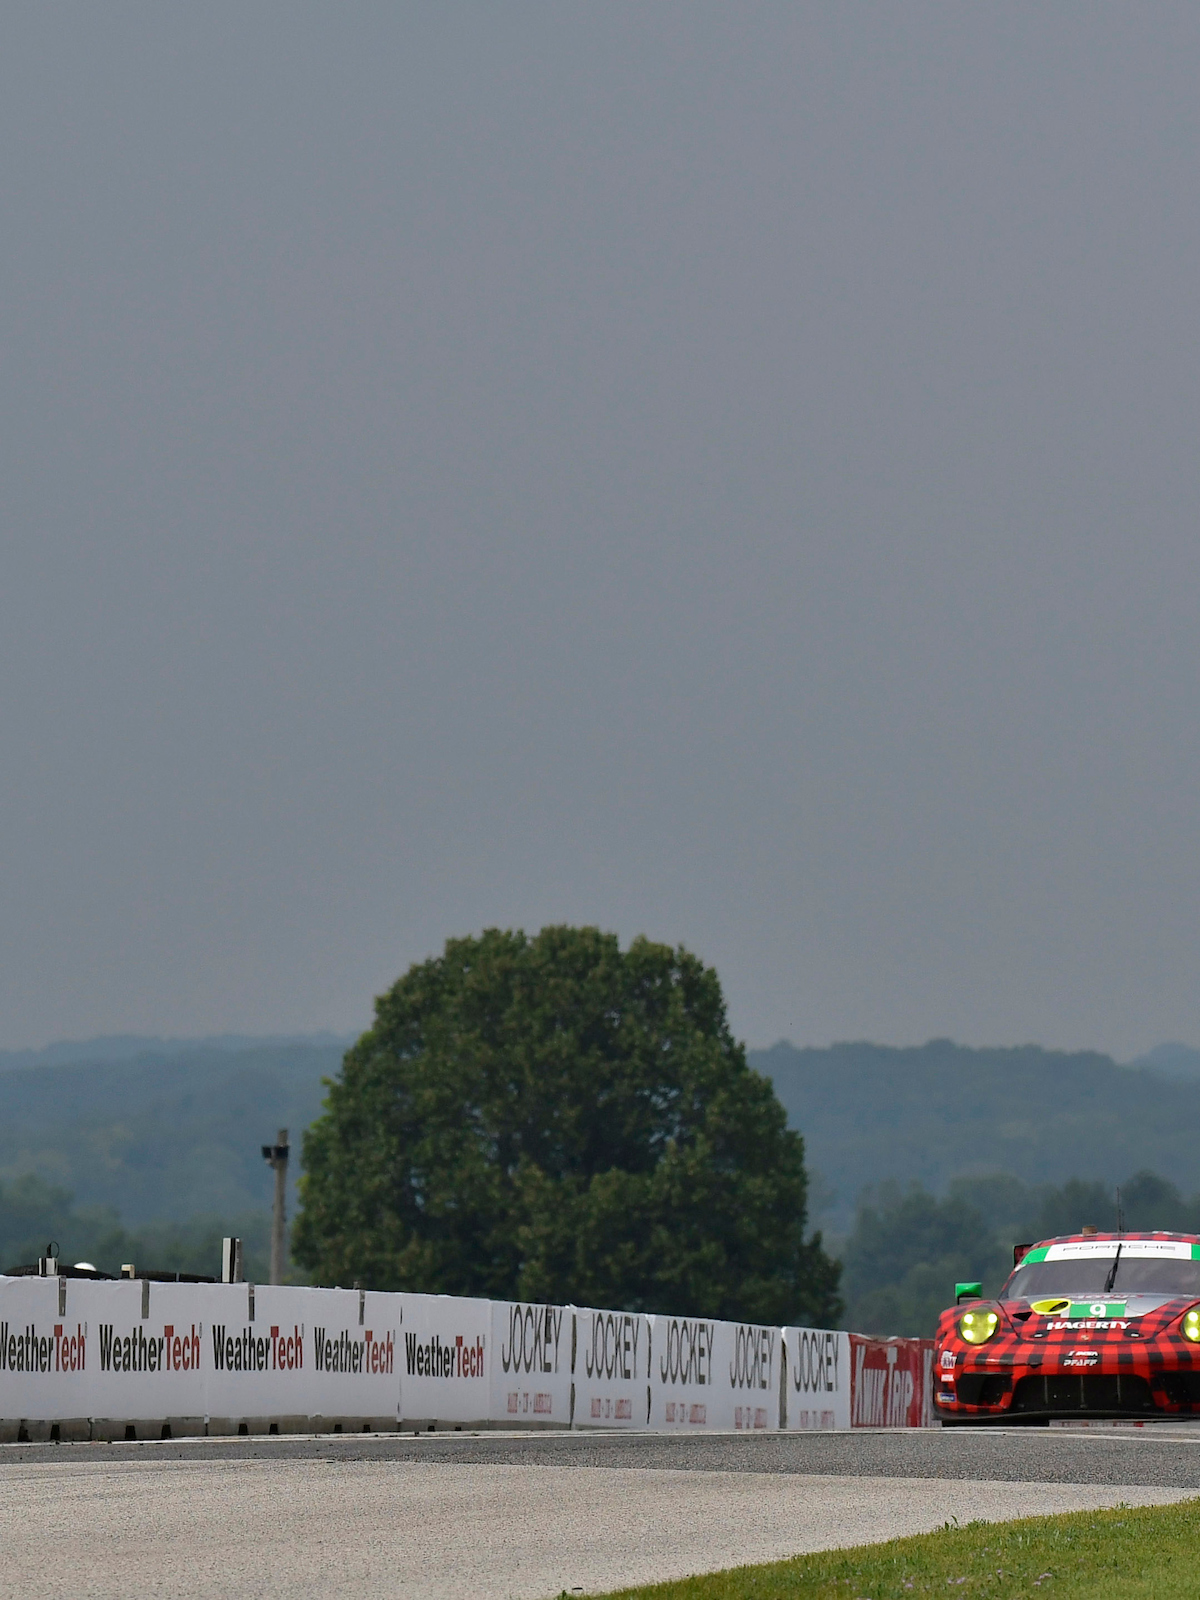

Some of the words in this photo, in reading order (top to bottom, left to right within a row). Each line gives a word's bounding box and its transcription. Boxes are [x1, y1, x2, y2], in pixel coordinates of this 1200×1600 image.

[1046, 1321, 1131, 1330] HAGERTY
[1089, 1304, 1106, 1318] 9
[99, 1324, 200, 1372] WeatherTech
[212, 1325, 303, 1371] WeatherTech
[314, 1327, 394, 1374] WeatherTech
[405, 1332, 483, 1378] WeatherTech
[502, 1304, 562, 1373] JOCKEY
[586, 1312, 639, 1380] JOCKEY
[660, 1319, 714, 1385] JOCKEY
[730, 1325, 774, 1389] JOCKEY
[793, 1331, 839, 1392] JOCKEY
